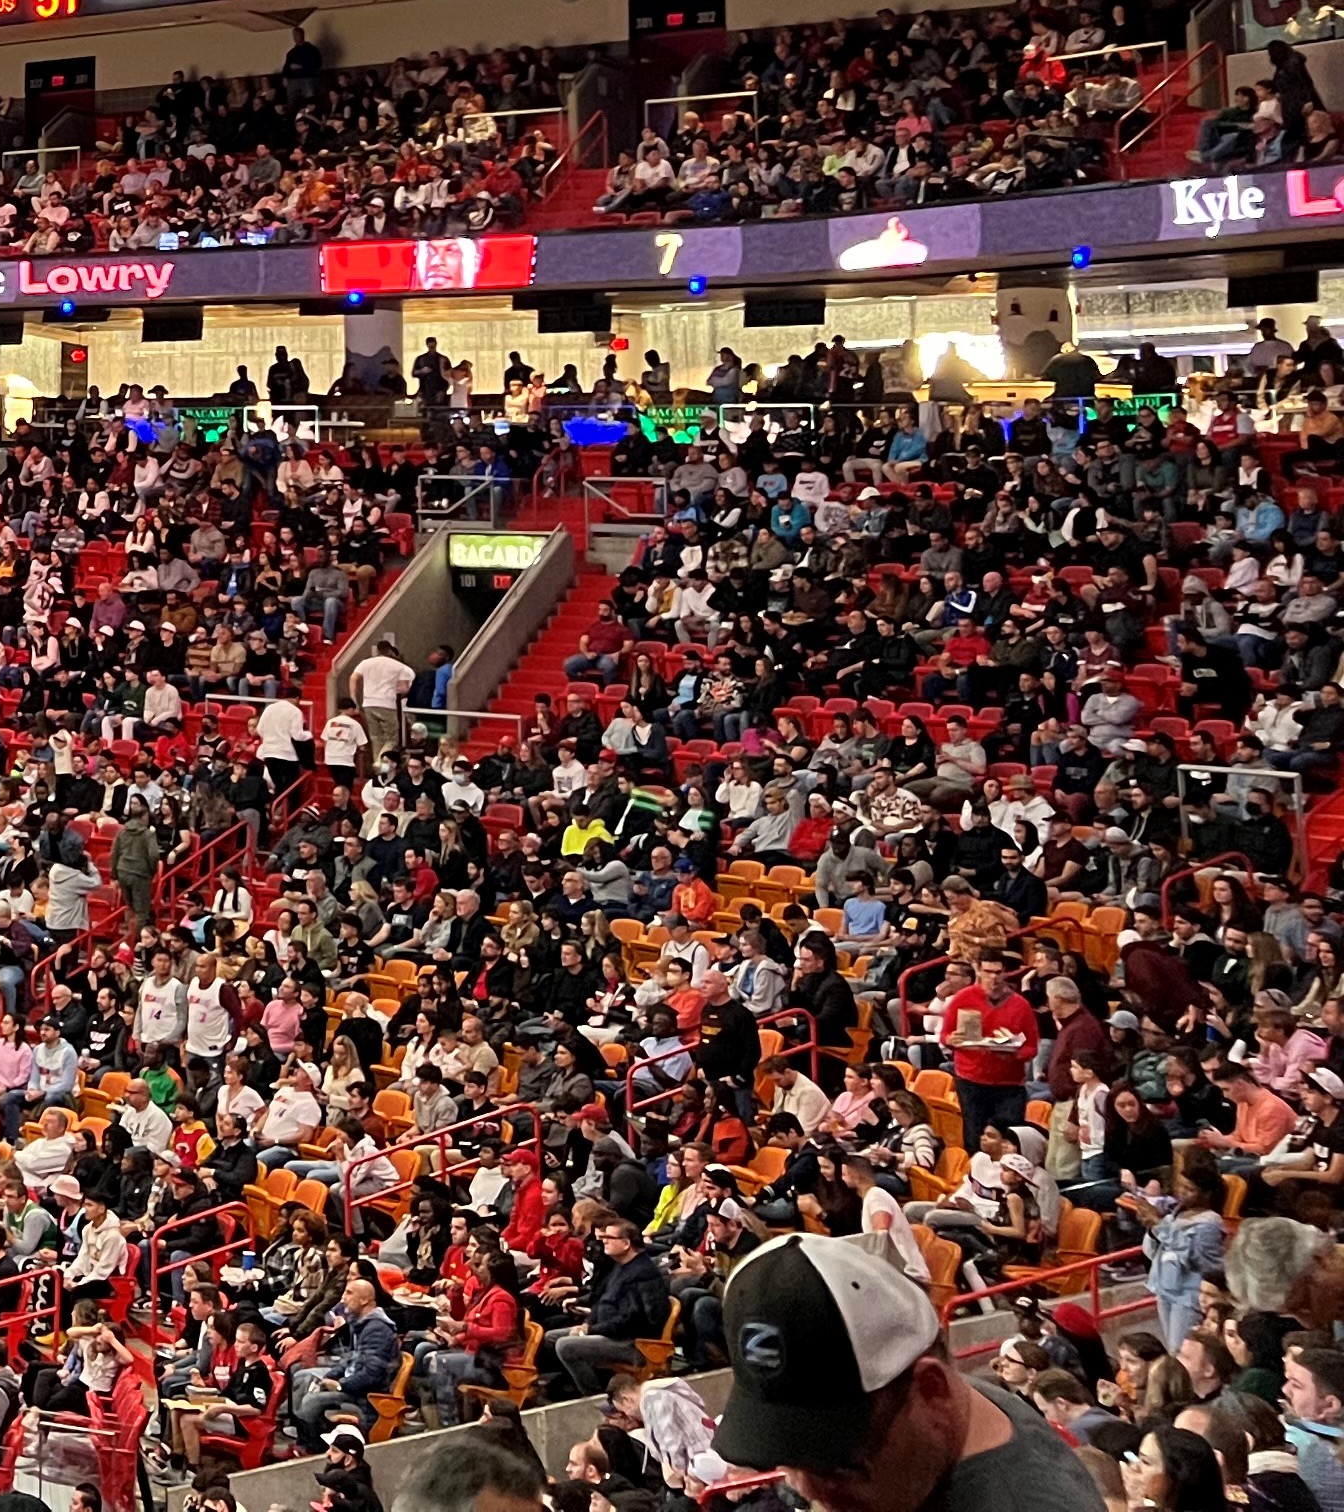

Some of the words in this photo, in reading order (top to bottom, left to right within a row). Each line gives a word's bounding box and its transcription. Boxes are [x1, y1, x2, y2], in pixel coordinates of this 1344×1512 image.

[1170, 175, 1265, 238] Kyle
[655, 233, 682, 274] 7
[19, 260, 175, 299] Lowry
[460, 574, 476, 587] 101
